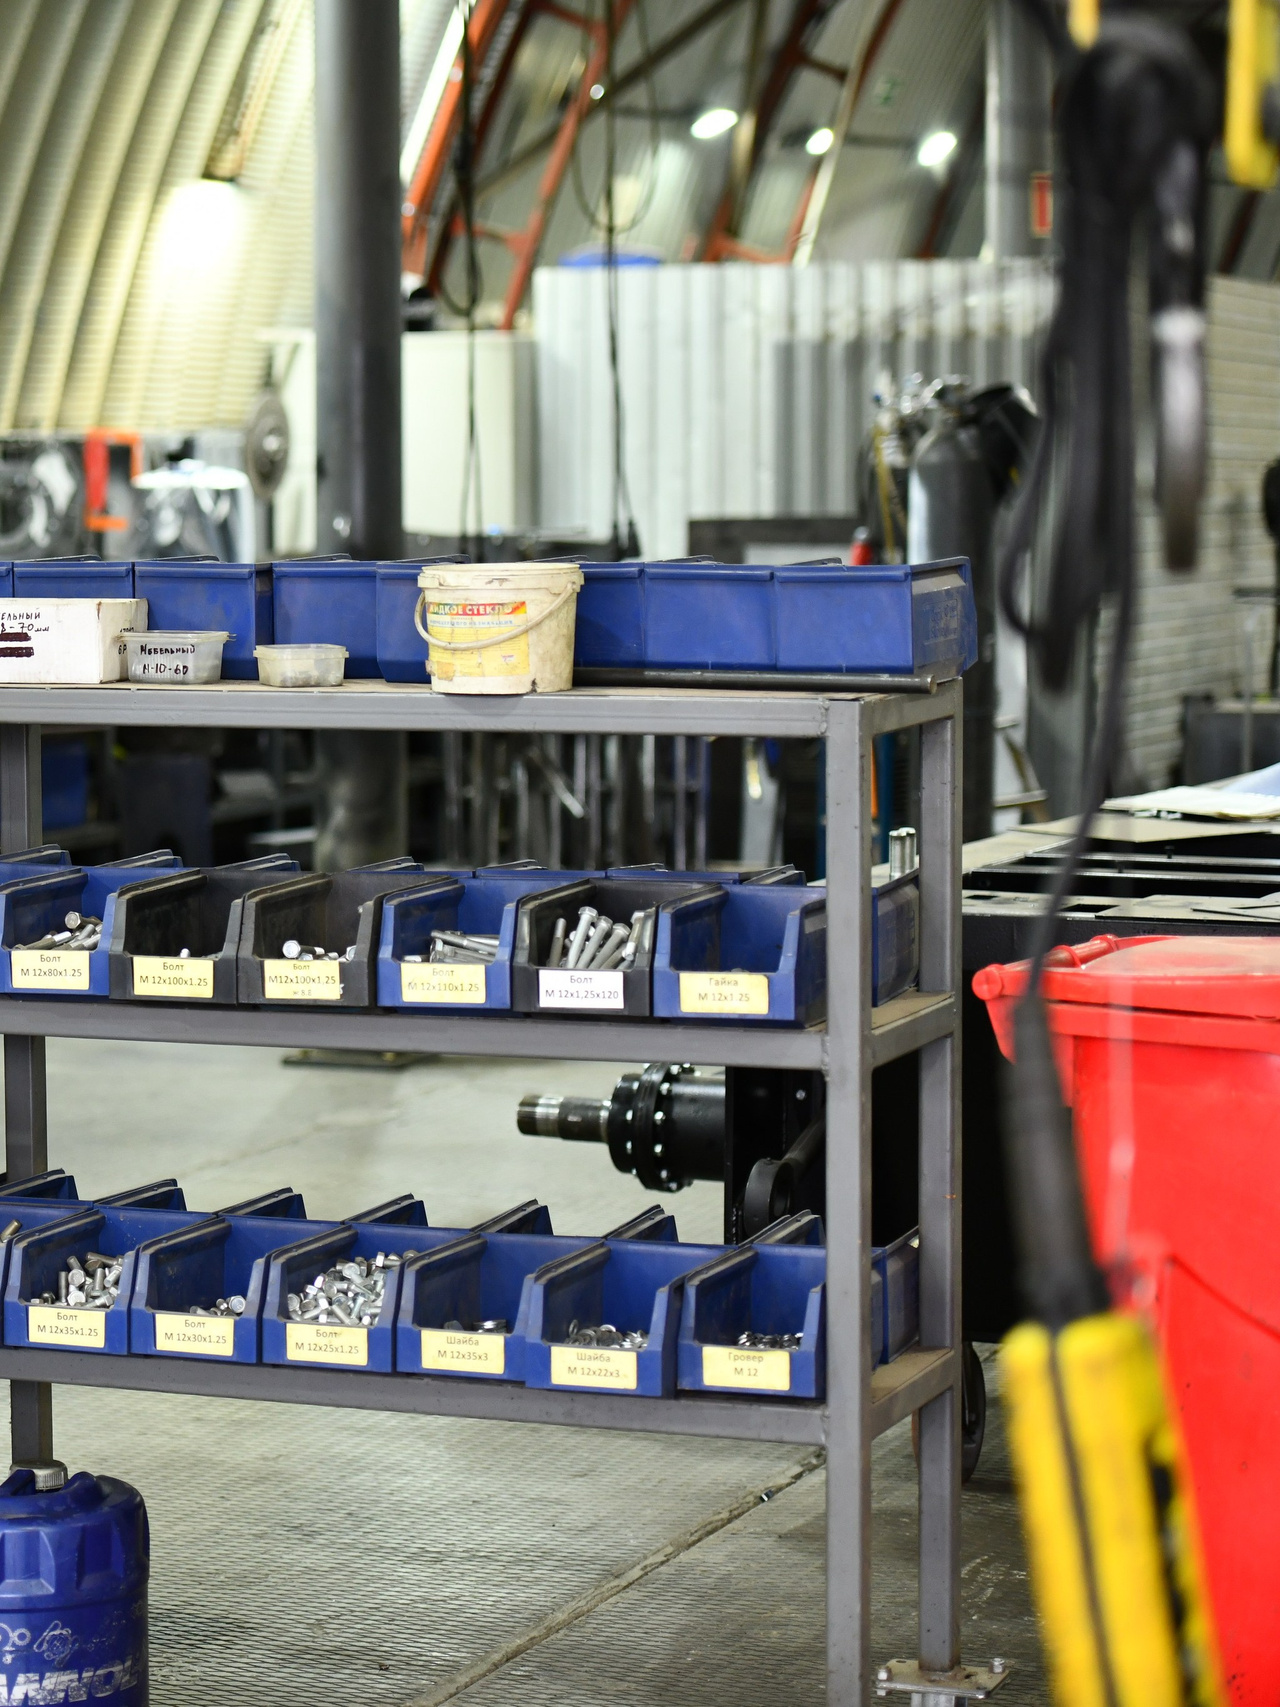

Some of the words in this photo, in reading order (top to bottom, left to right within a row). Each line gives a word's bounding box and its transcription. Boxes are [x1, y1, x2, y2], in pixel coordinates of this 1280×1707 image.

[40, 954, 61, 963] Болт
[162, 962, 184, 972] Болт
[20, 968, 30, 977] М
[432, 967, 455, 977] Болт
[139, 975, 149, 984] М
[569, 975, 593, 984] Болт
[709, 976, 739, 987] Гайка
[407, 982, 418, 991] М
[545, 989, 555, 999] М
[698, 993, 708, 1001] М
[56, 1312, 78, 1321] Болт
[37, 1324, 47, 1333] М
[184, 1319, 206, 1329] Болт
[164, 1332, 174, 1341] М
[315, 1329, 338, 1339] Болт
[446, 1336, 479, 1346] Шайба
[295, 1342, 305, 1351] М
[437, 1350, 448, 1359] М
[576, 1352, 611, 1363] Шайба
[727, 1351, 764, 1364] Гровер
[567, 1366, 578, 1375] М
[734, 1367, 744, 1376] М
